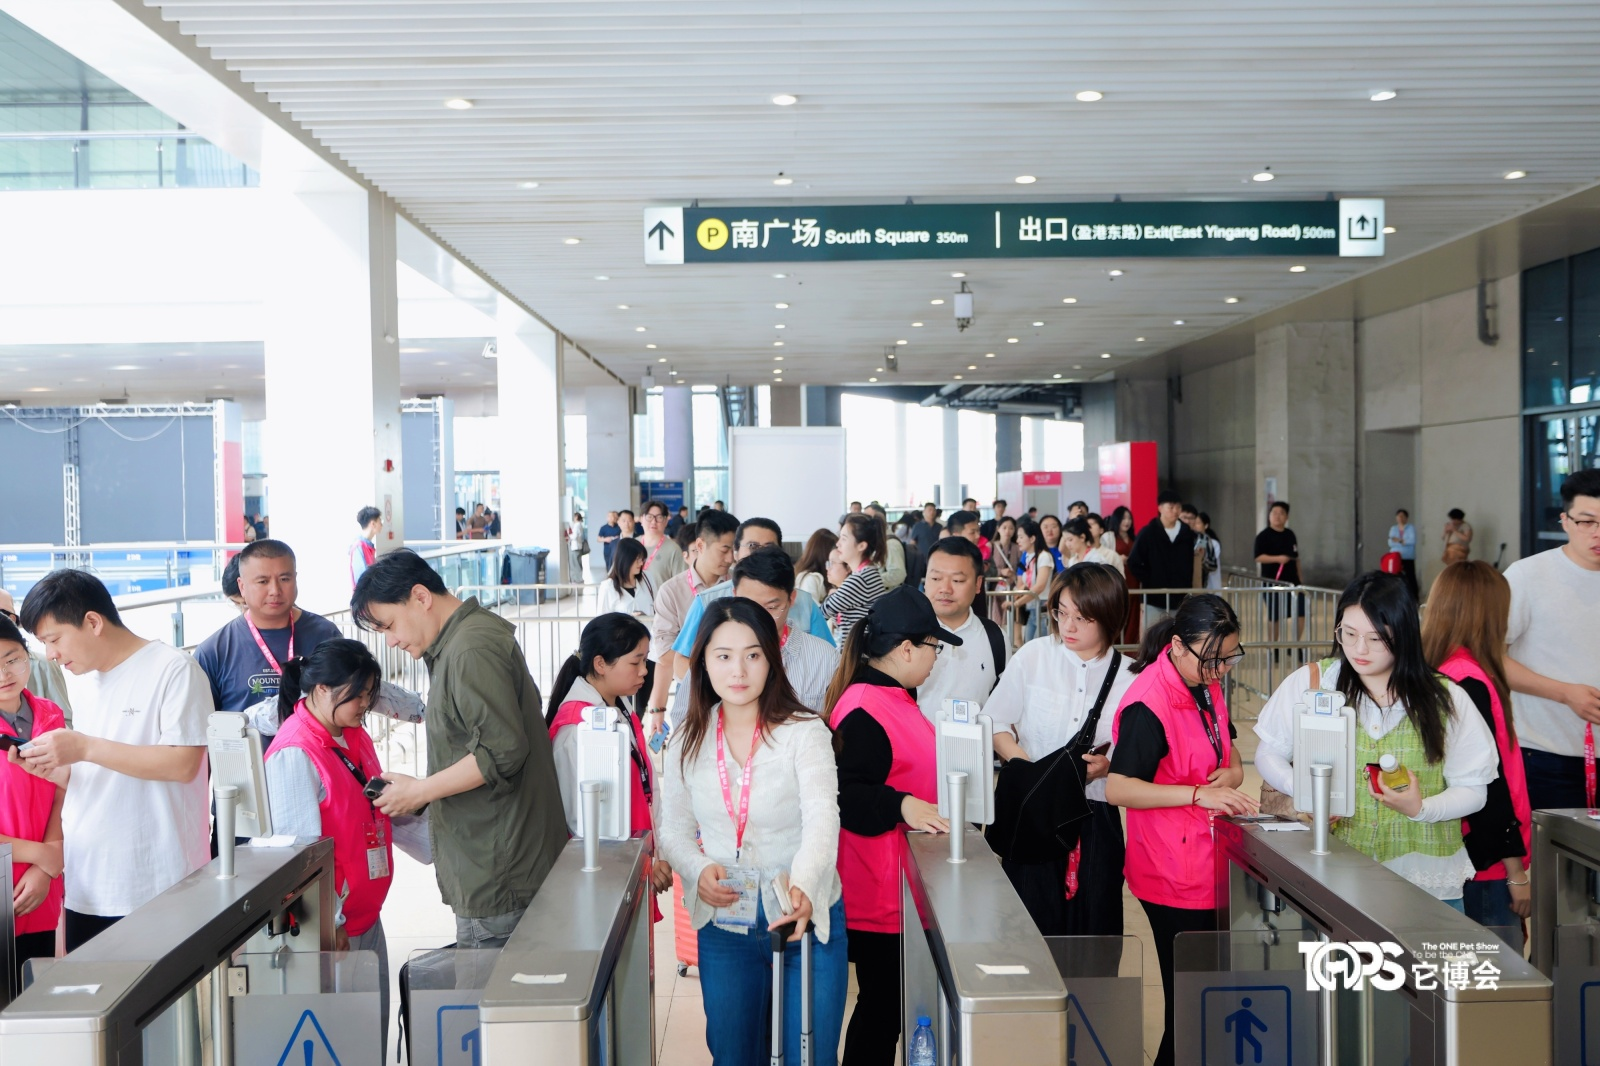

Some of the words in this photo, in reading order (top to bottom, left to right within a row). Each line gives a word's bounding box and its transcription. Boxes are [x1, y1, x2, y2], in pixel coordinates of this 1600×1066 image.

[731, 218, 821, 249] 南广场
[824, 228, 871, 244] South
[874, 228, 930, 247] Square
[936, 231, 969, 244] 350m
[1019, 215, 1067, 242] 出口
[1204, 225, 1259, 241] Yingang
[1261, 224, 1301, 241] Road)
[1302, 226, 1336, 239] 500m
